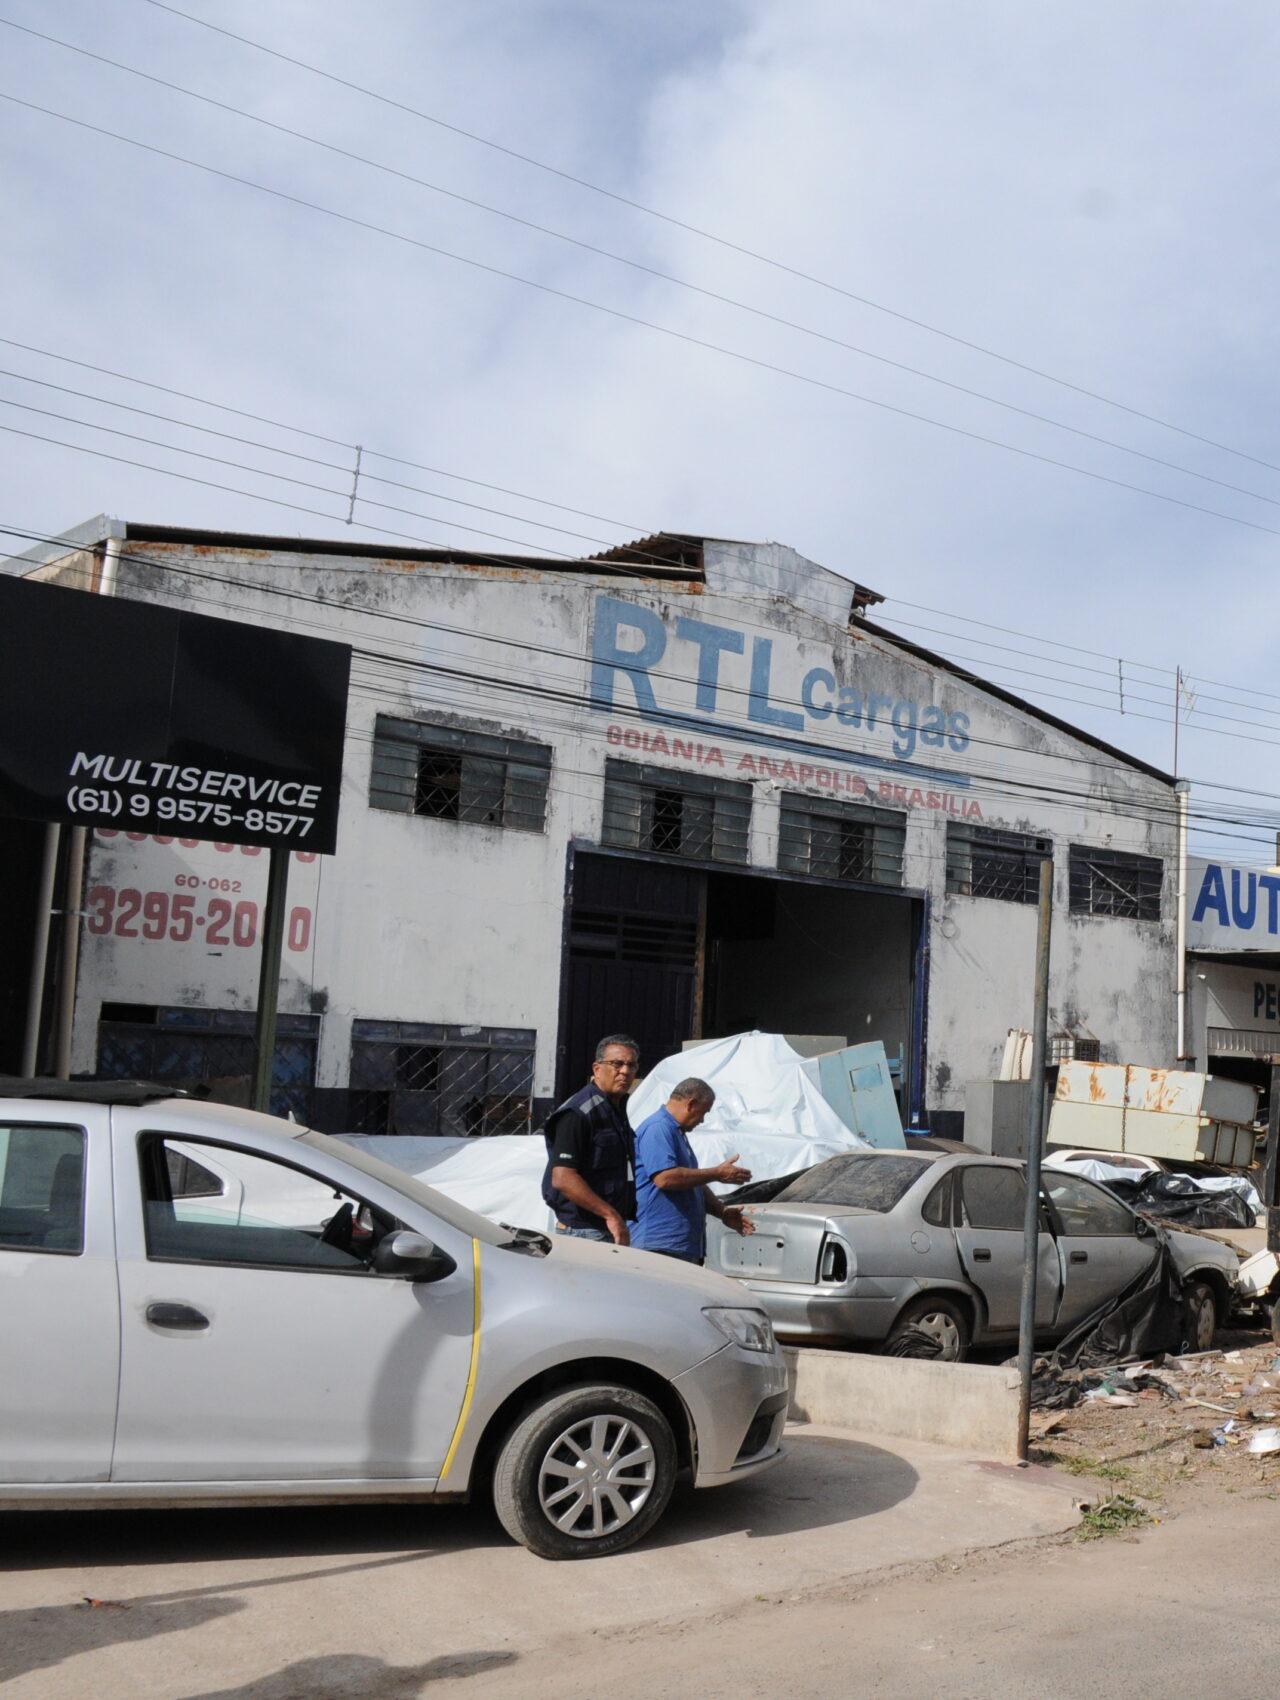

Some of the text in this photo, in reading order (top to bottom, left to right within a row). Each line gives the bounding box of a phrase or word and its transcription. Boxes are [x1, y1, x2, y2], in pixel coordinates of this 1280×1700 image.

[590, 595, 804, 732] RTL
[69, 752, 321, 808] MULTISERVICE
[606, 725, 983, 818] GOIÂNIA ANÁPOLIS BRASÍLIA
[67, 785, 314, 837] (61) 9 9575-8577
